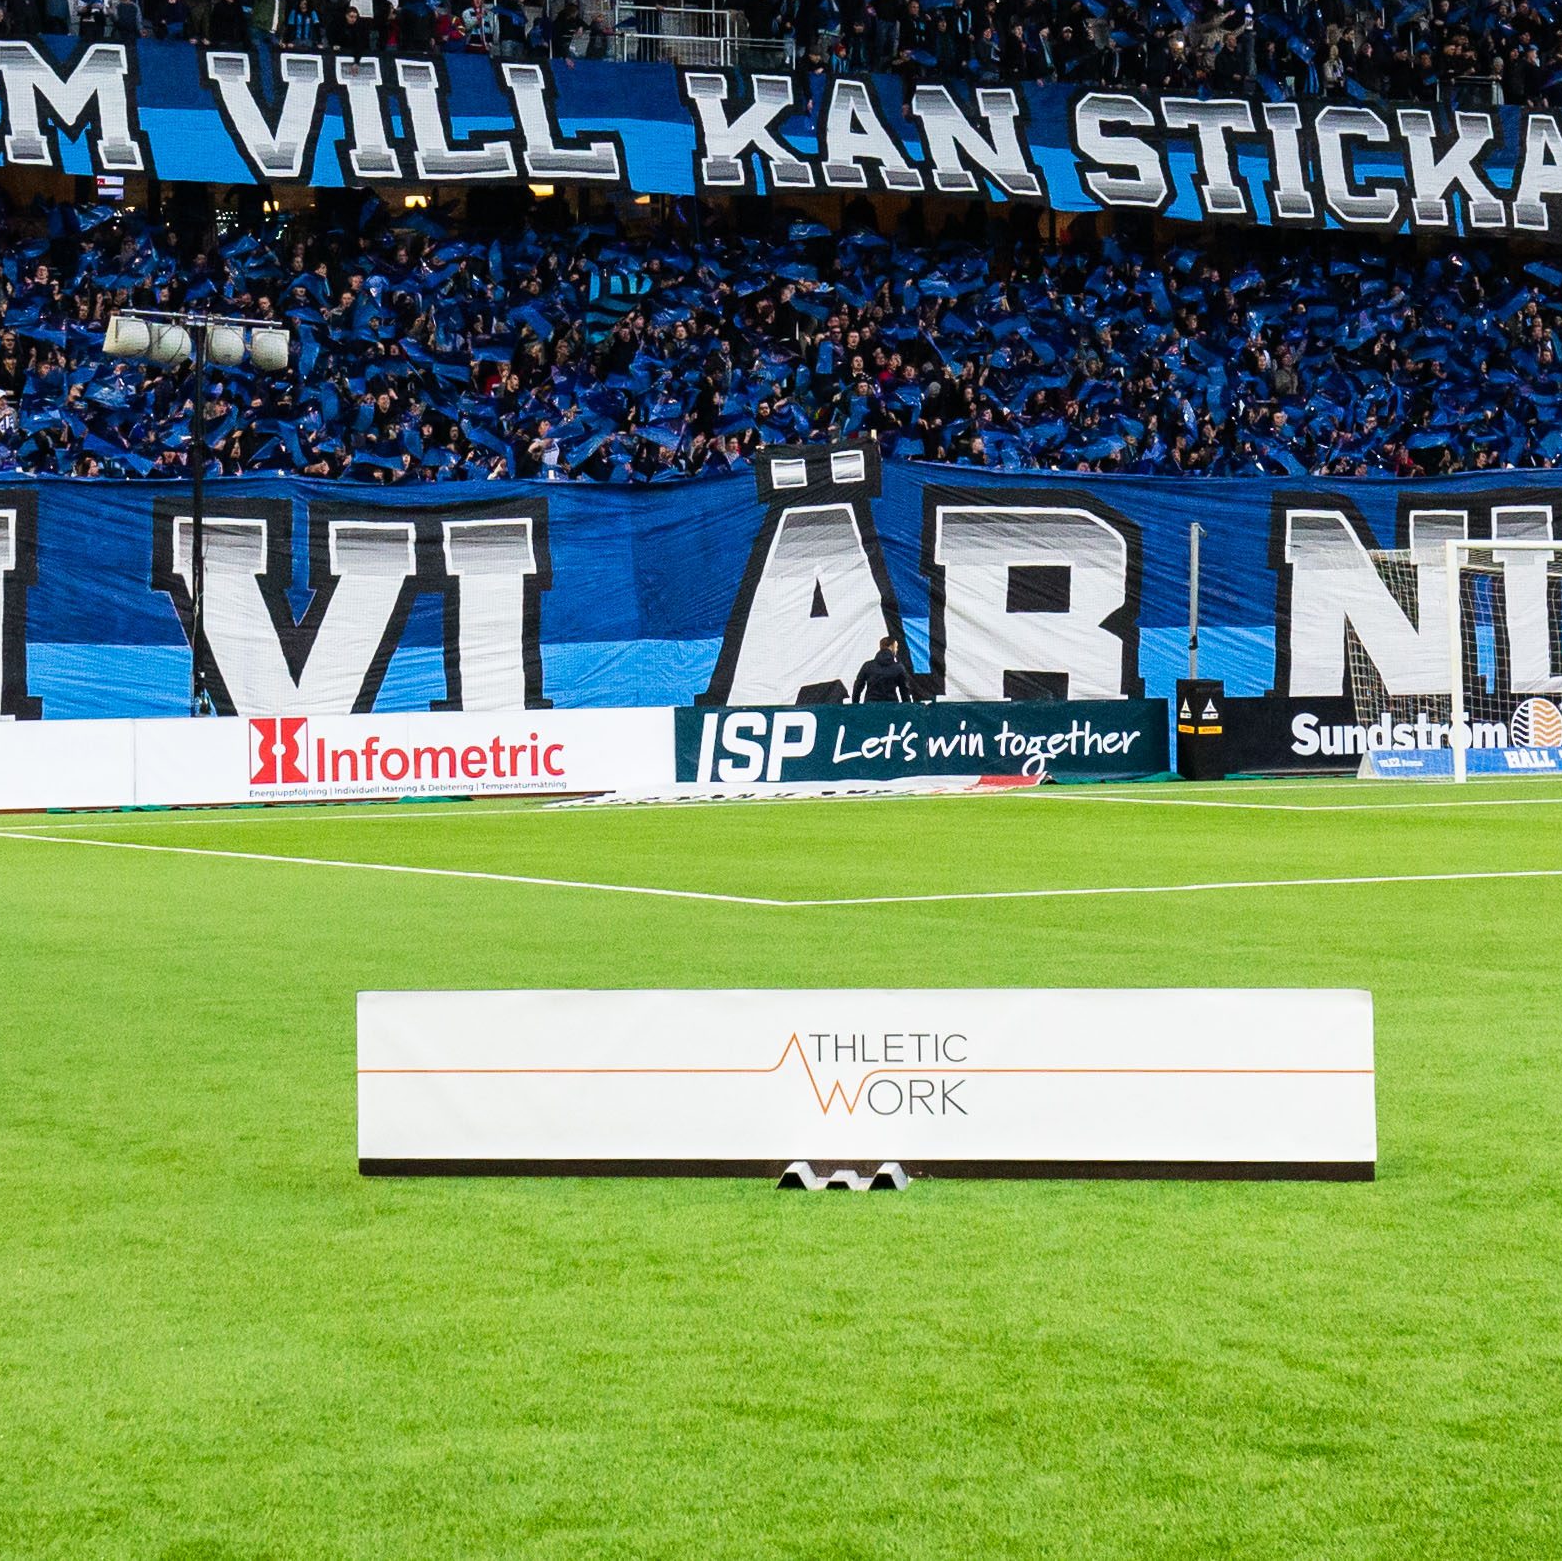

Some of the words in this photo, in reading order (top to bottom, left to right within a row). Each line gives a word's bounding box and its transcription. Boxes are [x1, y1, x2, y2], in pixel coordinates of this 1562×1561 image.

[207, 51, 621, 183] VILL
[683, 72, 1043, 197] KAN
[170, 514, 539, 719] VI
[723, 450, 1130, 706] ÄR
[316, 732, 566, 783] Infometric
[696, 711, 817, 783] ISP
[832, 721, 918, 765] Let's
[926, 719, 985, 760] win
[994, 720, 1141, 778] together
[249, 786, 328, 799] Energiuppföljning
[334, 785, 380, 795] Individuell
[428, 782, 474, 793] Debitering
[481, 780, 568, 791] Temperaturmätning
[779, 1031, 968, 1063] ATHLETIC
[811, 1078, 969, 1116] WORK
